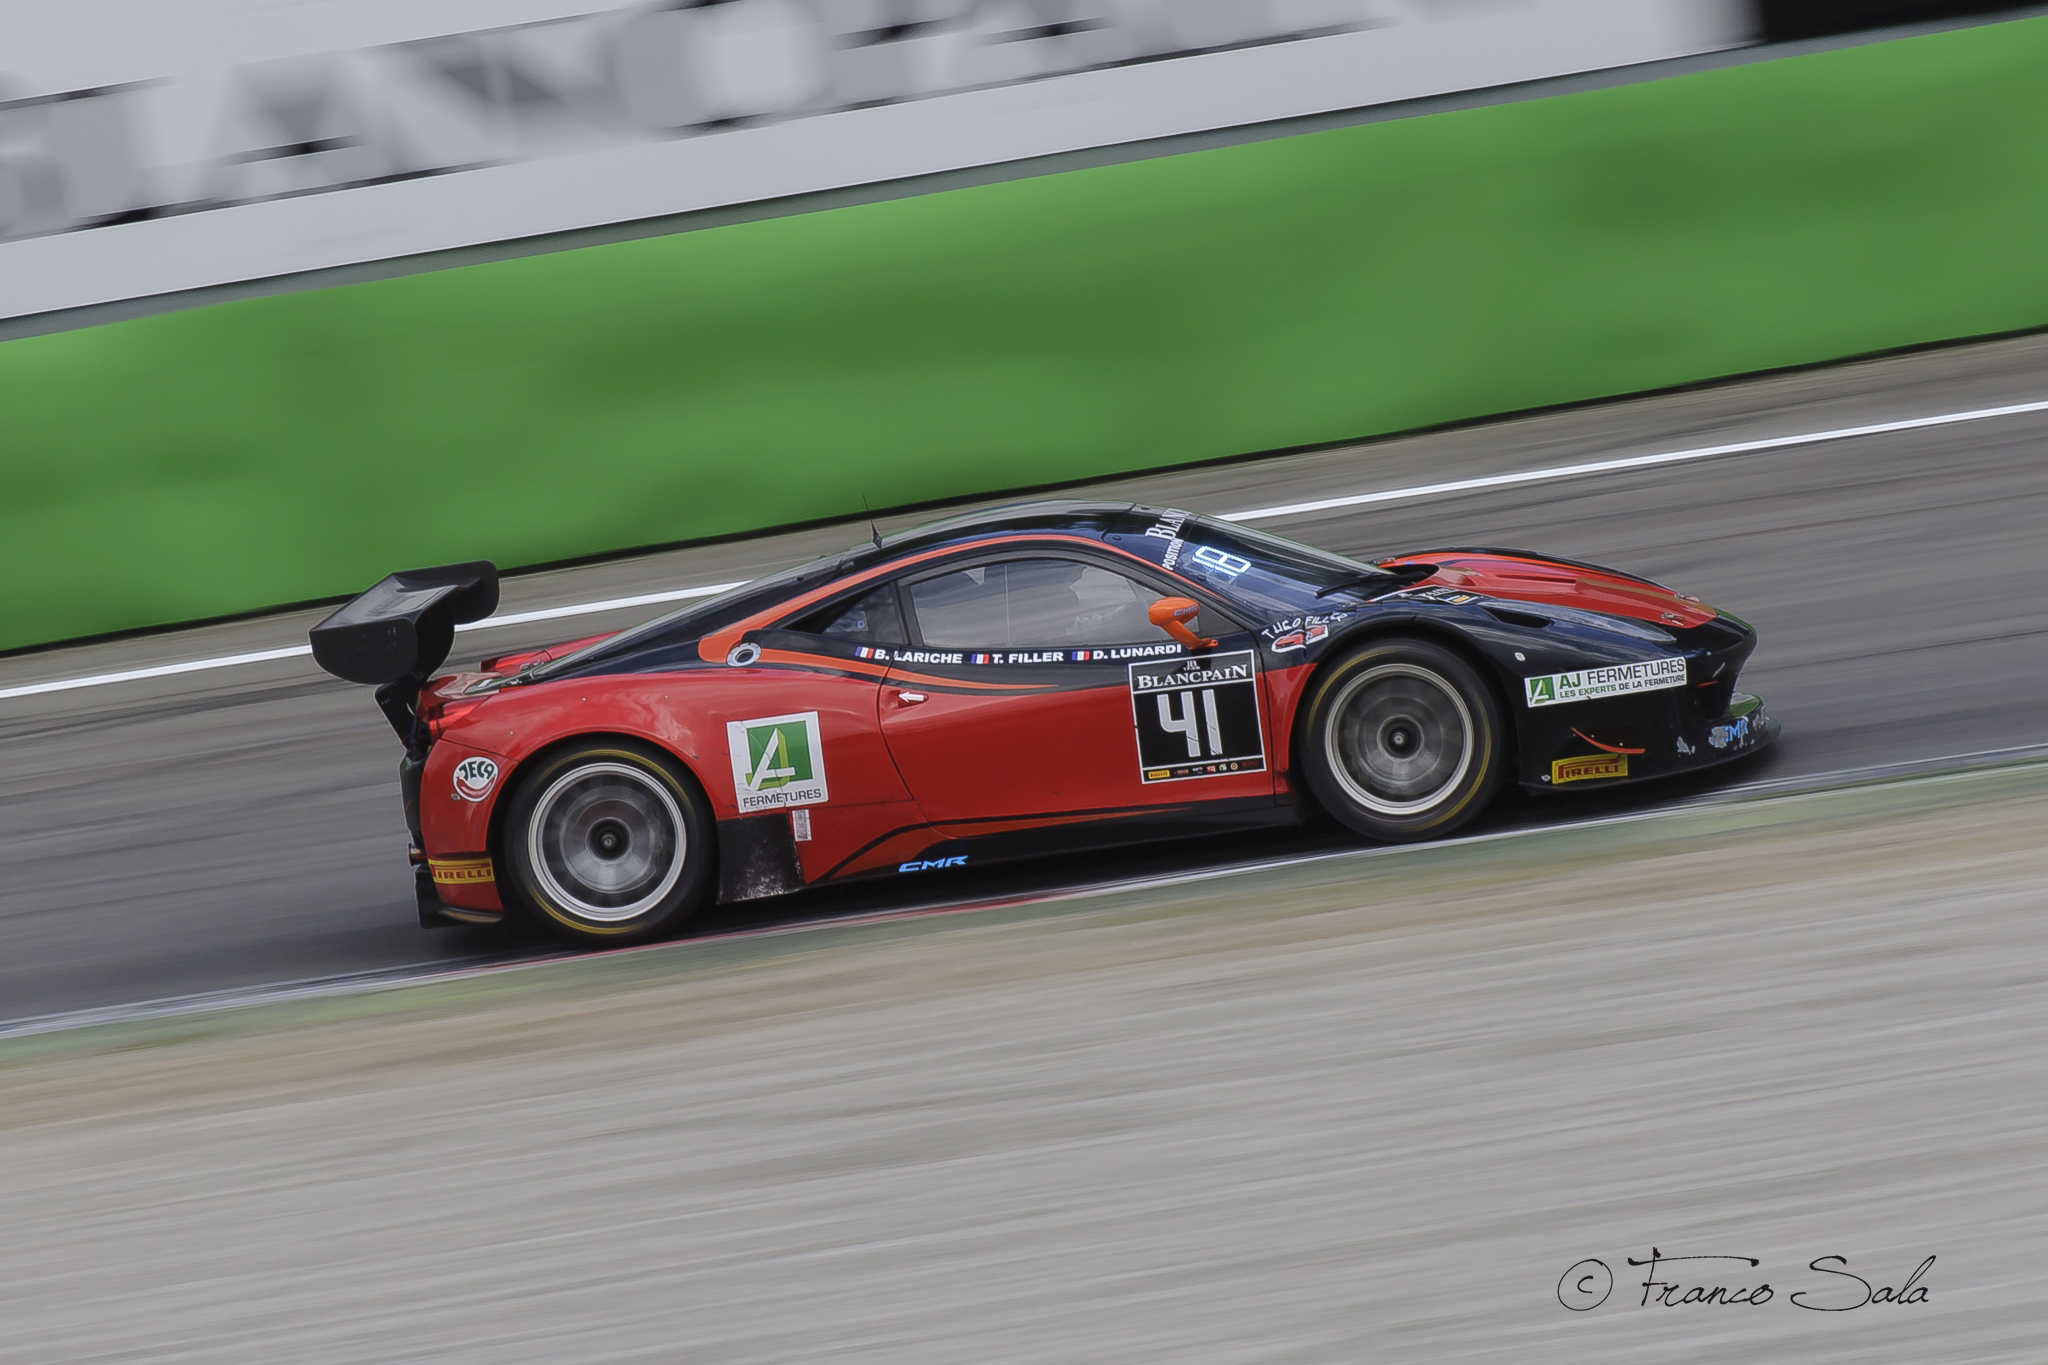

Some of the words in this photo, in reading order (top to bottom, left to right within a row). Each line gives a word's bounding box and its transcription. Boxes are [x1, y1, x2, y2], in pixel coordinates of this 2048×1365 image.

[1162, 538, 1184, 571] POSITION
[873, 649, 890, 660] B.
[894, 651, 963, 664] LARICHE
[992, 653, 1004, 664] T.
[1008, 651, 1064, 664] FILLER
[1092, 649, 1108, 660] D.
[1110, 643, 1182, 659] LUNARDI
[1136, 664, 1248, 690] BLANCPAIN
[1558, 673, 1582, 690] AJ
[1587, 658, 1685, 686] FERMETURES
[1559, 688, 1576, 699] LES
[1578, 684, 1617, 697] EXPERTS
[1618, 682, 1631, 691] DE
[1632, 680, 1643, 689] LA
[1644, 674, 1686, 688] FERMETURE
[1156, 689, 1223, 758] 41
[1557, 757, 1620, 780] PIRELLI
[743, 788, 822, 808] FERMETURES
[430, 862, 492, 880] PIRELLI
[898, 855, 969, 873] CMR
